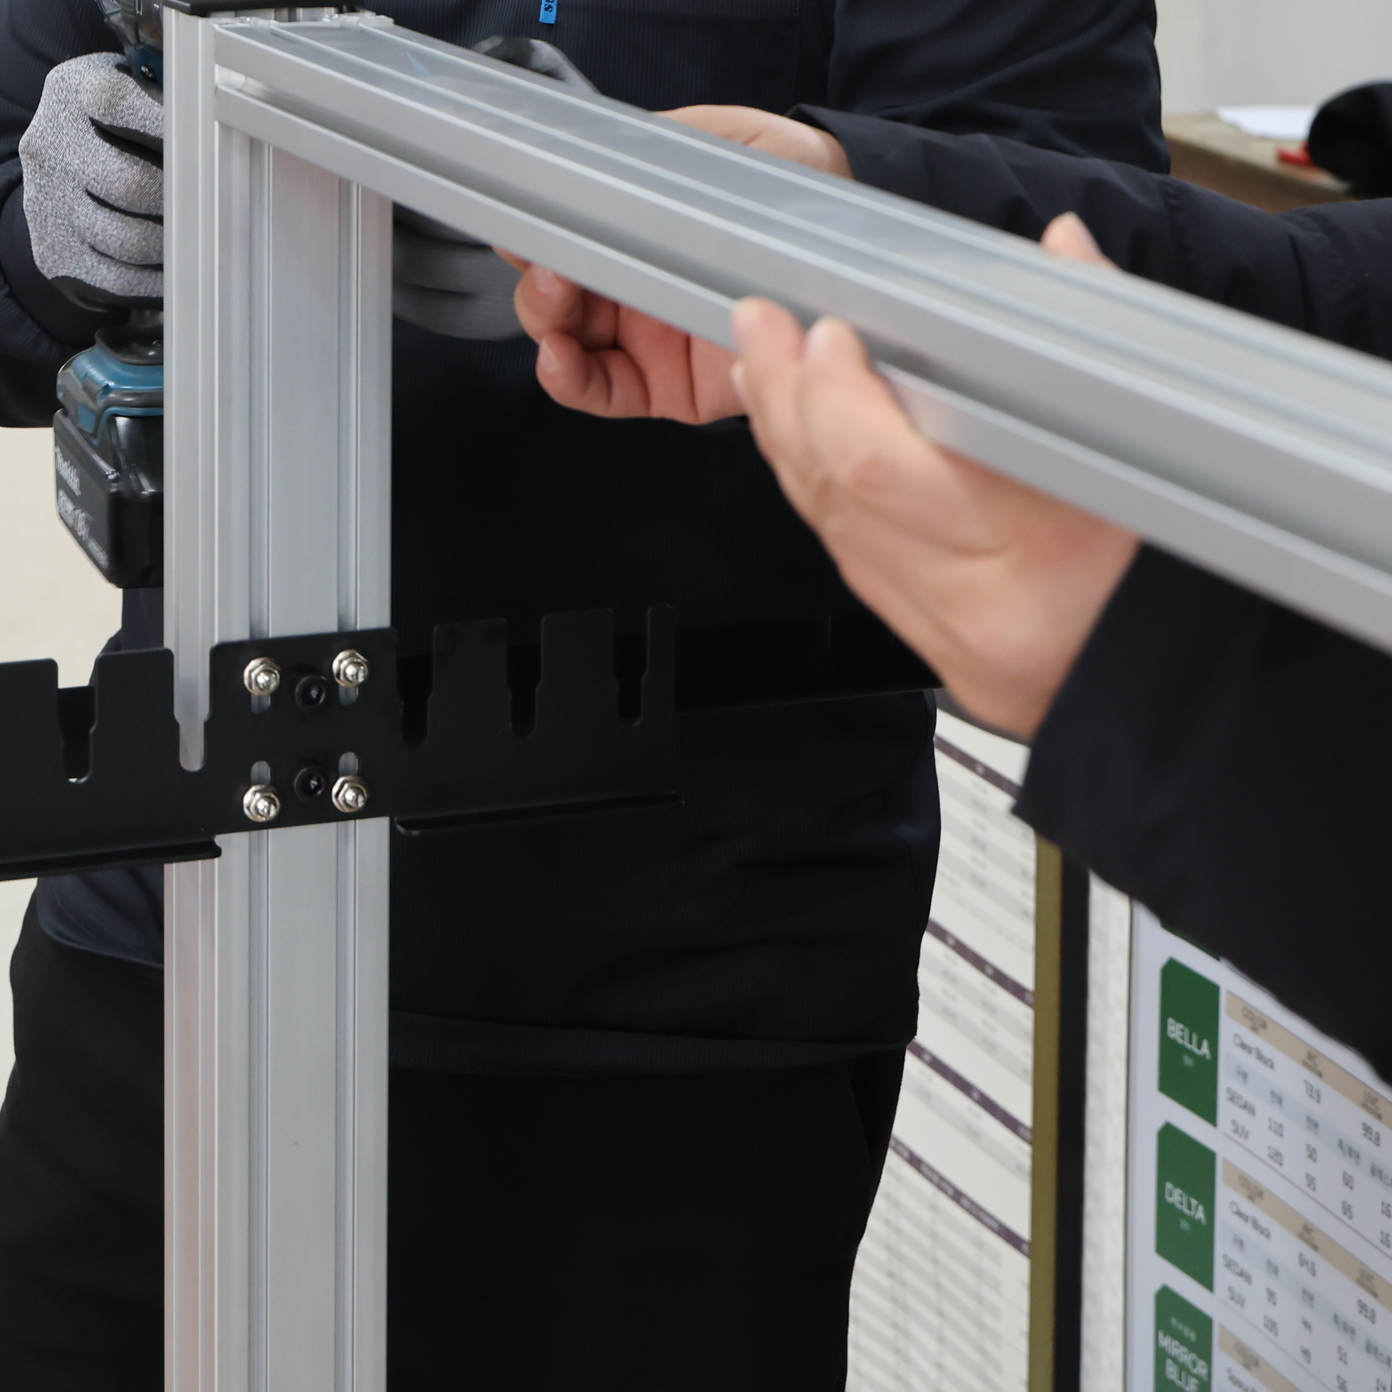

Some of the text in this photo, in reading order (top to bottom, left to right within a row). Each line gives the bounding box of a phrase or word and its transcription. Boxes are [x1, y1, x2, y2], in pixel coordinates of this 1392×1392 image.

[1167, 1017, 1211, 1060] BELLA
[1165, 1181, 1206, 1226] DELTA
[1158, 1329, 1208, 1382] MIRROR
